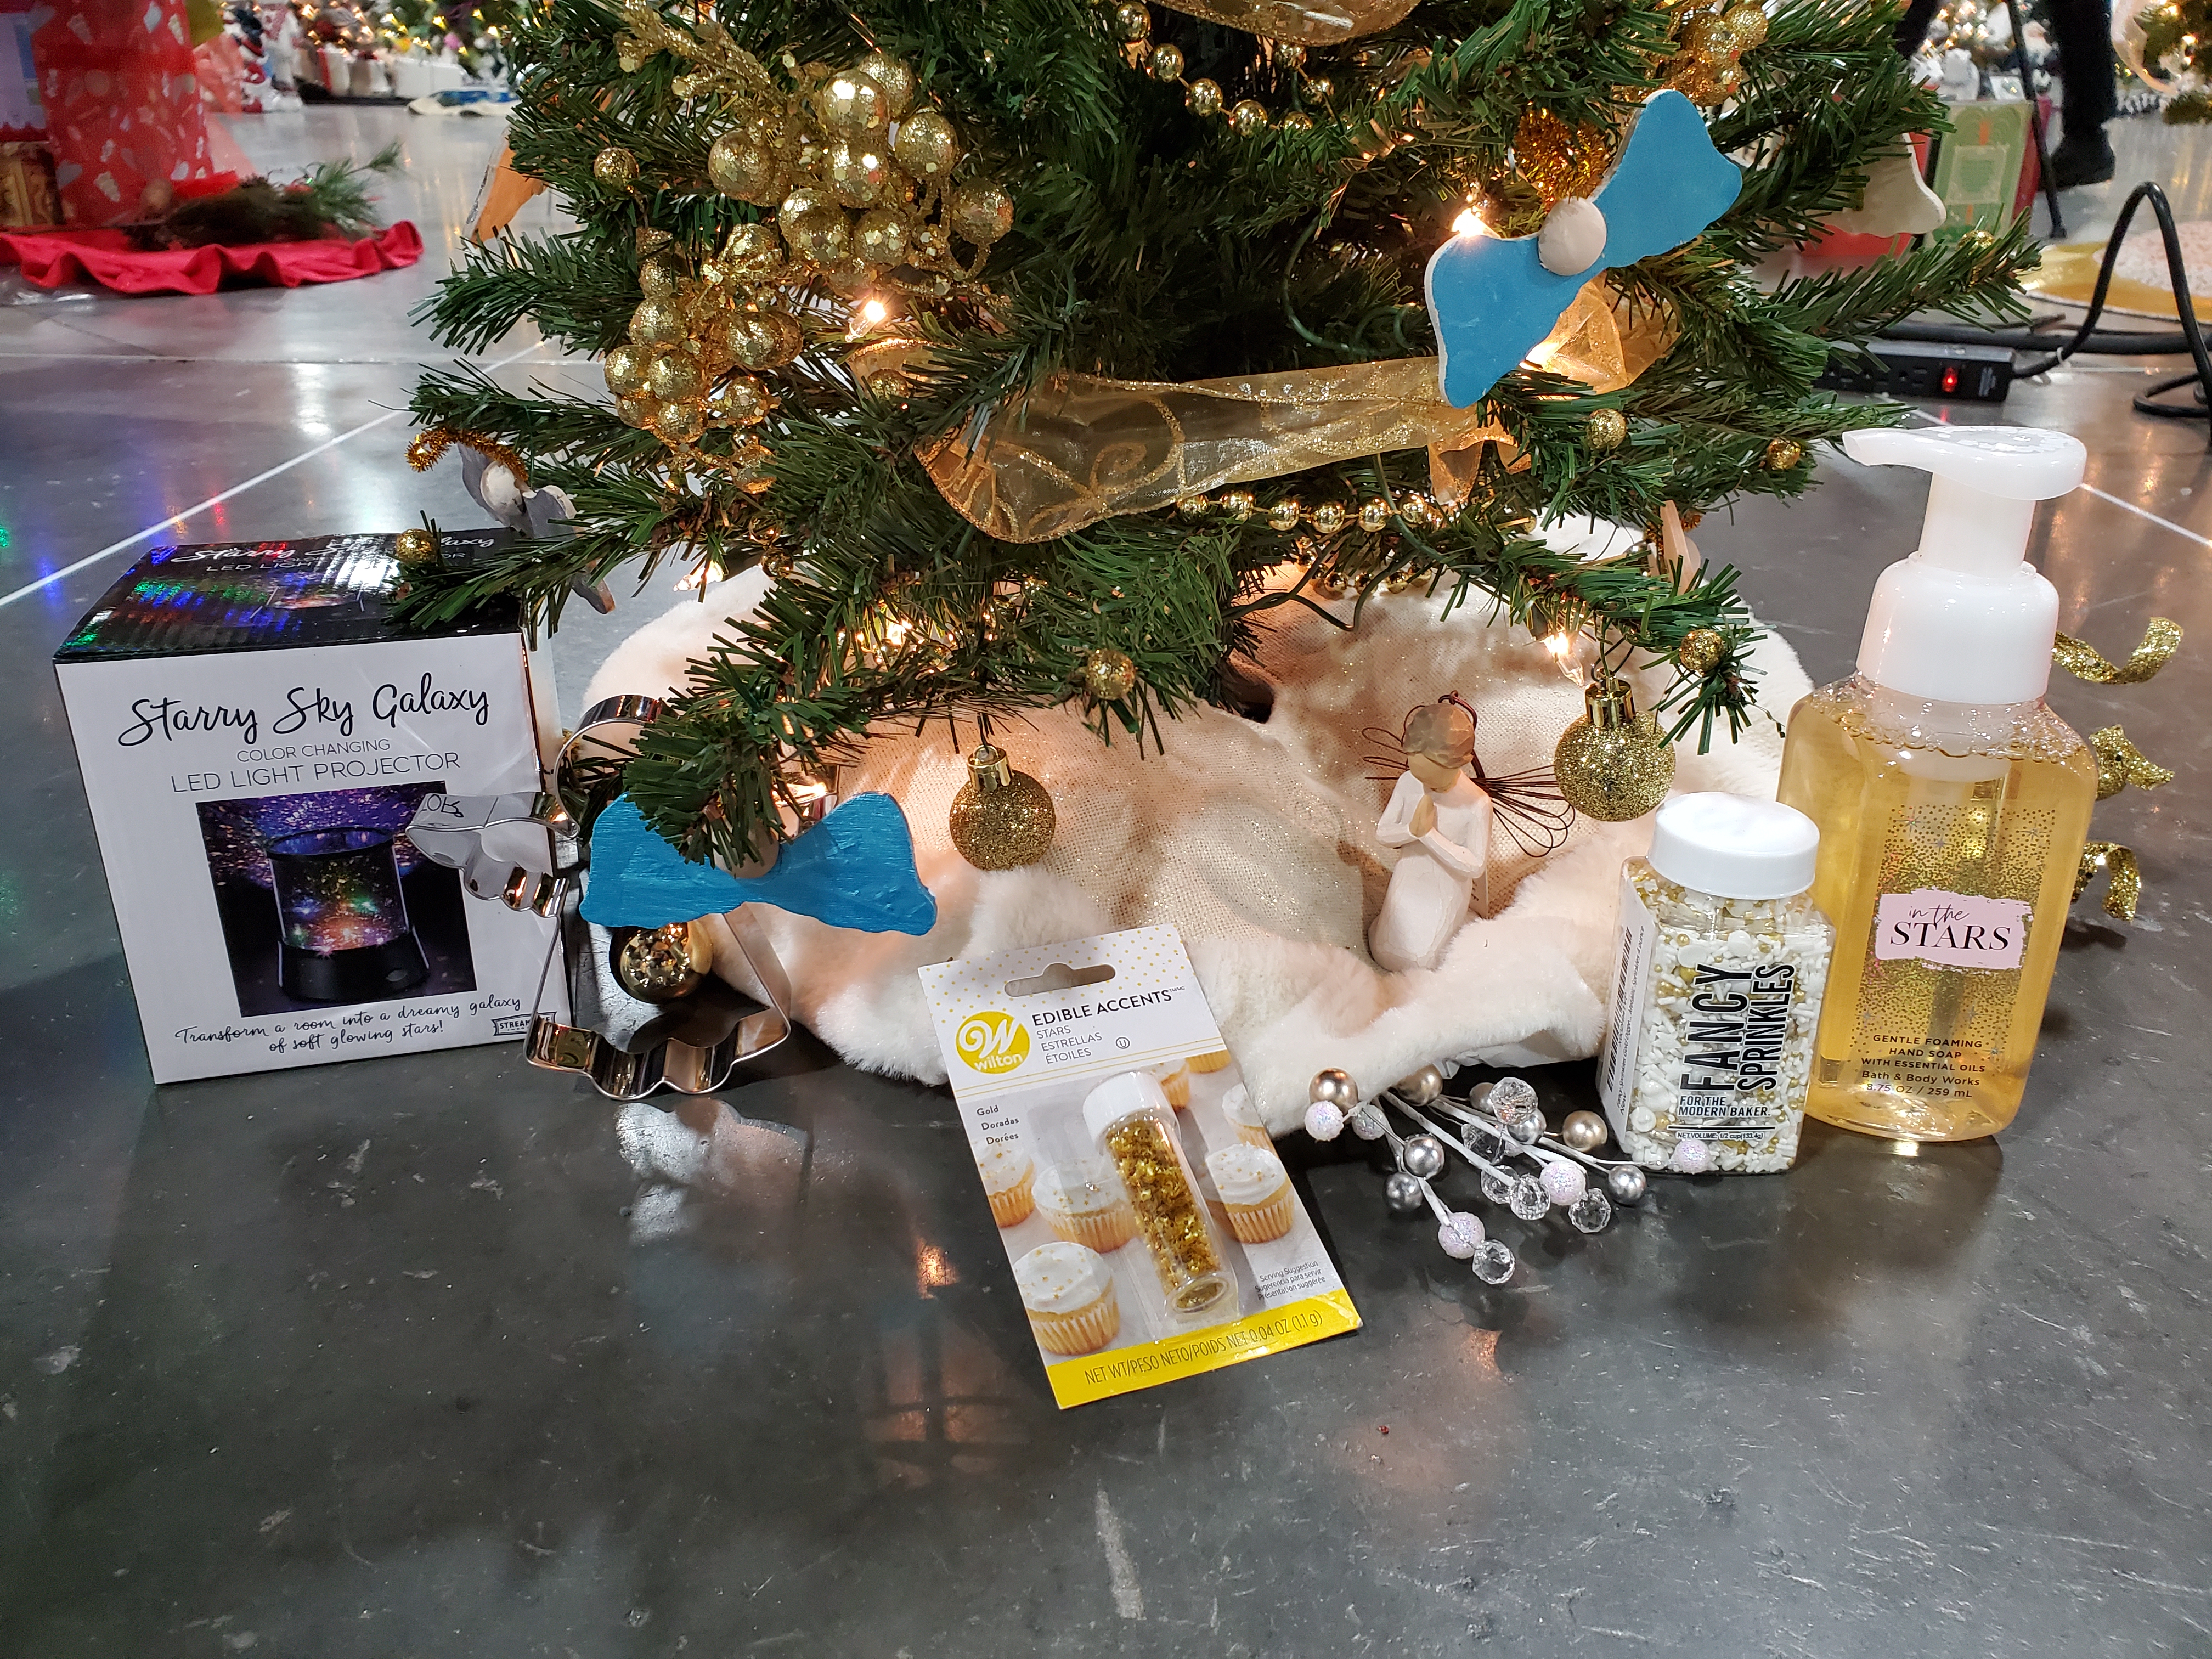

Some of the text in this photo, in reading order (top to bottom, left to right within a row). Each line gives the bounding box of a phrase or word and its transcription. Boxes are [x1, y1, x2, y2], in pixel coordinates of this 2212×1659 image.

[170, 548, 296, 562] Starry
[118, 672, 489, 747] Starry Sky Galaxy
[237, 738, 390, 763] COLOR CHANGING
[172, 752, 461, 793] LED LIGHT PROJECTOR
[1909, 904, 1970, 923] in the
[1890, 921, 2011, 950] STARS
[175, 1026, 269, 1043] Transform
[294, 1020, 336, 1030] room
[343, 1011, 373, 1025] into
[398, 1005, 459, 1018] dreamy
[469, 994, 521, 1015] galaxy
[1031, 1005, 1092, 1026] EDIBLE
[269, 1019, 444, 1053] of soft glowing stars!
[1036, 1025, 1071, 1039] STARS
[1680, 964, 1752, 1090] FANCY
[1737, 964, 1795, 1090] SPRINKLES
[1041, 1032, 1102, 1052] ESTRELLAS
[1873, 1035, 1982, 1048] GENTLE FOAMING
[974, 1052, 1023, 1071] wilton
[1046, 1047, 1092, 1064] ÉTOILES
[1889, 1047, 1962, 1059] HAND SOAP
[1861, 1058, 1891, 1066] WITH
[1894, 1060, 1955, 1070] ESSENTIAL
[1862, 1070, 1889, 1080] Bath
[1906, 1074, 1938, 1084] Body
[1943, 1076, 1980, 1086] Works
[1866, 1083, 1891, 1092] 8.75
[1896, 1085, 1913, 1094] OZ
[1916, 1086, 1925, 1095] /
[1927, 1087, 1950, 1096] 259
[977, 1104, 999, 1115] Gold
[1680, 1096, 1726, 1105] FOR THE
[1678, 1107, 1771, 1116] MODERN BAKER.
[981, 1118, 1019, 1130] Doradas
[986, 1133, 1019, 1144] Dorées
[1255, 1268, 1322, 1293] Sugerencia para servir
[1259, 1261, 1318, 1282] Serving Suggestion
[1257, 1276, 1325, 1301] Présentation suggérée
[1084, 1367, 1108, 1385] NET
[1108, 1357, 1159, 1379] WT/PESO
[1160, 1337, 1226, 1365] NETO/POIDS
[1226, 1330, 1248, 1351] NET
[1249, 1324, 1274, 1343] 0.04
[1276, 1319, 1291, 1335] OZ
[1310, 1310, 1323, 1327] g)
